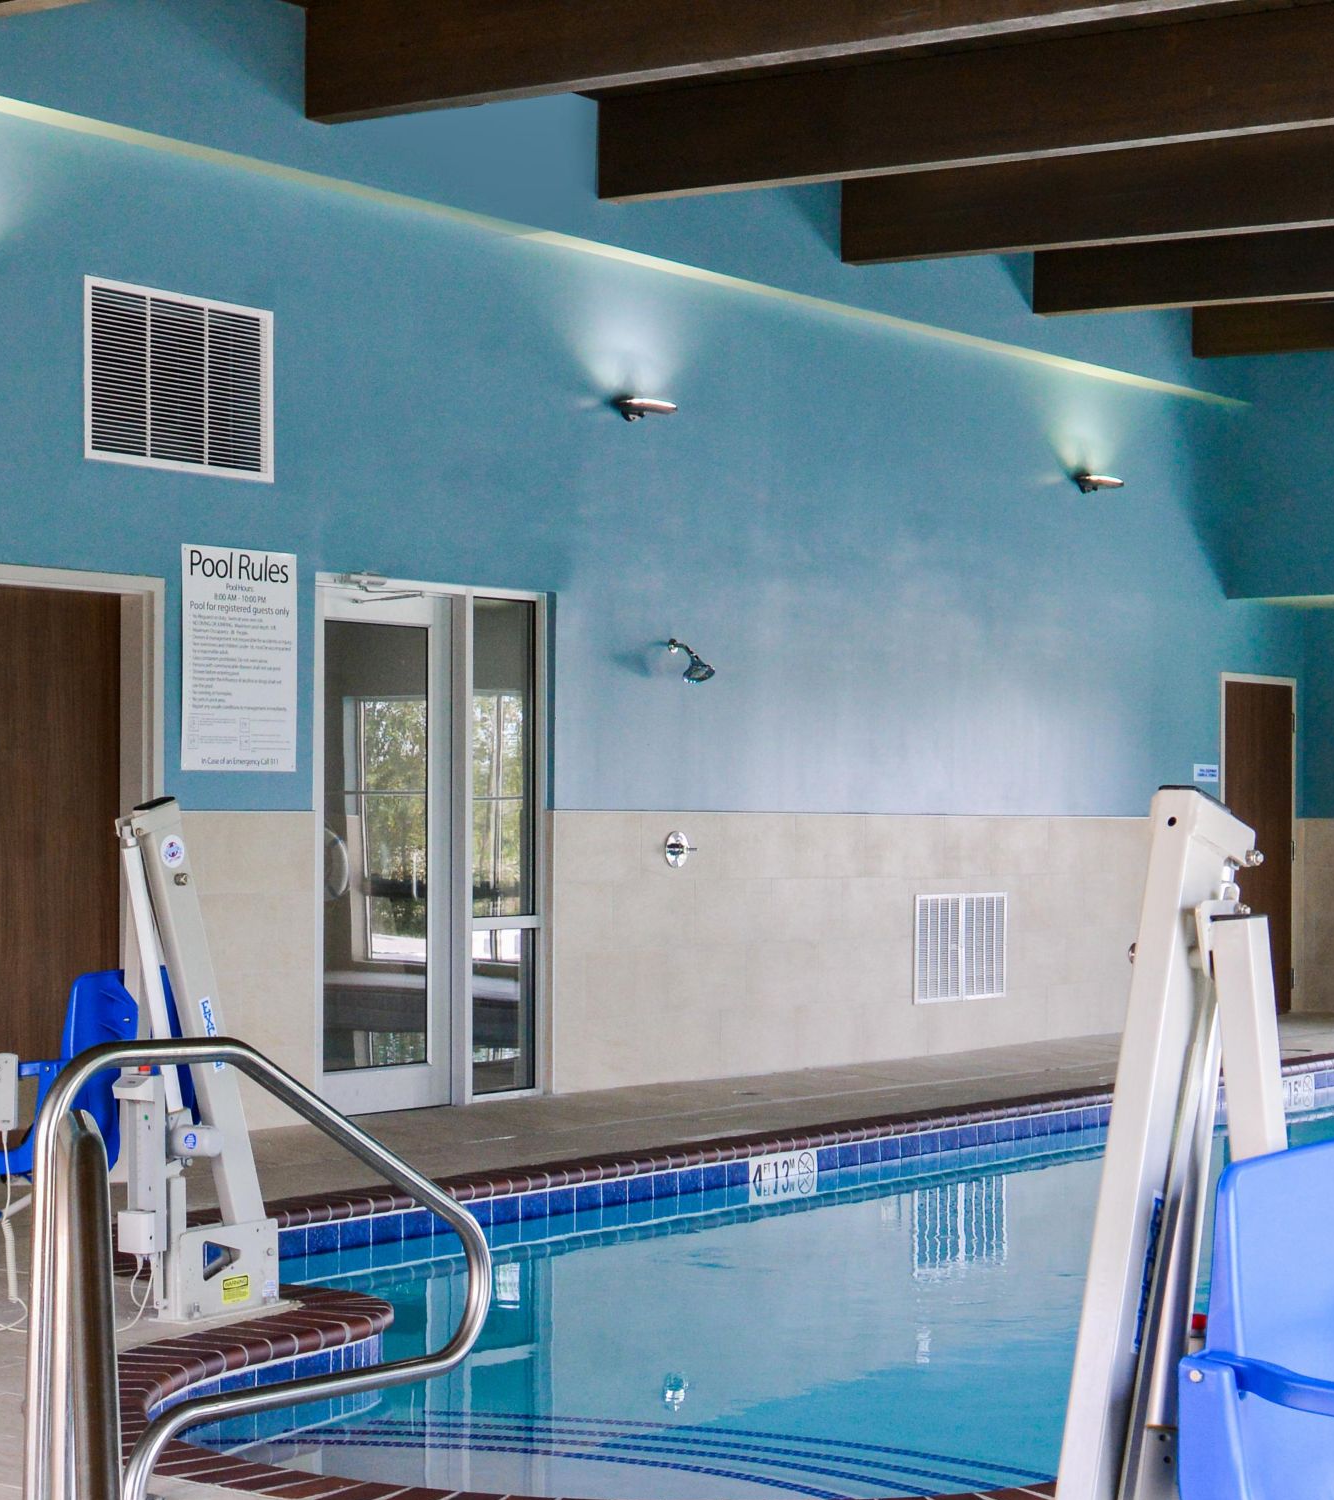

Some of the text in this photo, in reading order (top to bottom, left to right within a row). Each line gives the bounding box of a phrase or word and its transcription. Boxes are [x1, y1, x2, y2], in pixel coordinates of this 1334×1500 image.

[190, 549, 289, 583] Pool Rules
[226, 583, 238, 591] Pool
[190, 600, 289, 617] Pool for registered guests only
[233, 758, 260, 767] Emergency
[764, 1163, 771, 1173] FT
